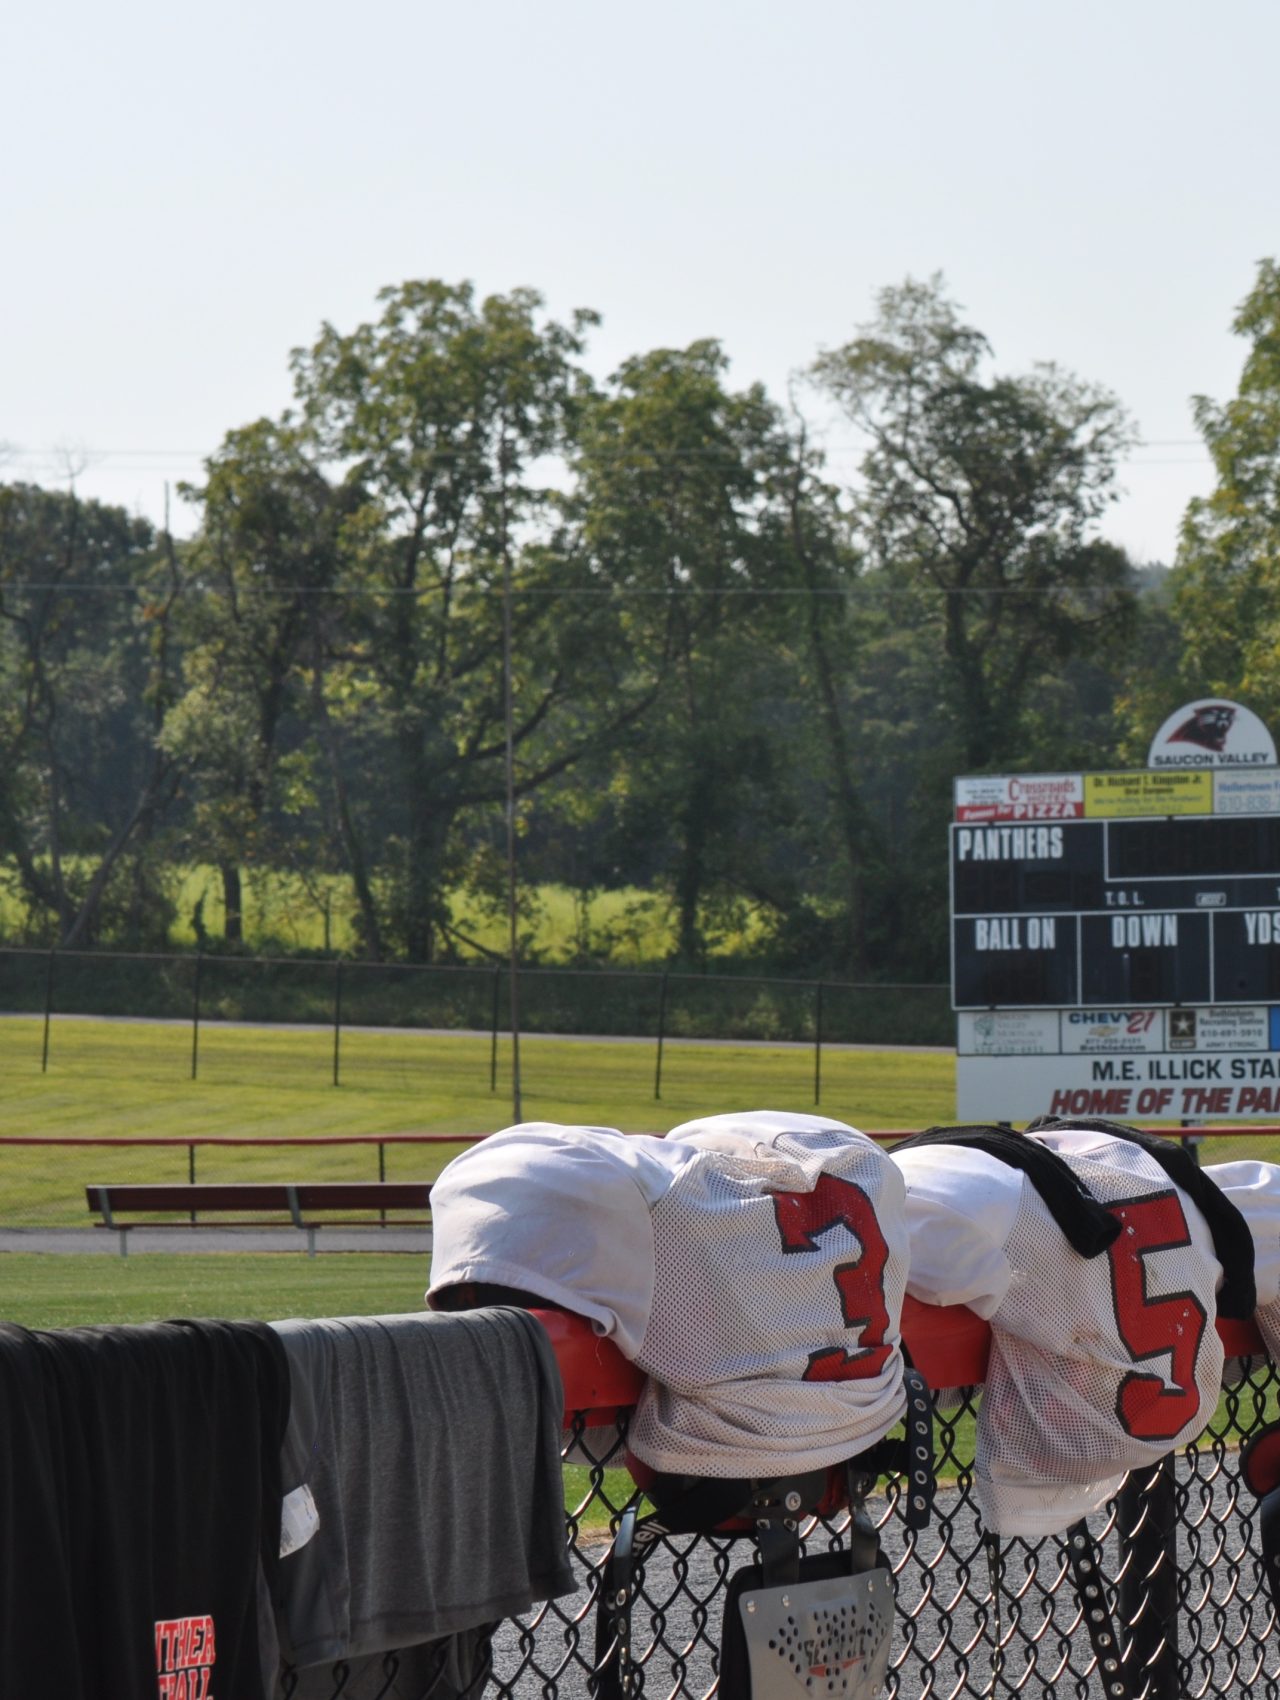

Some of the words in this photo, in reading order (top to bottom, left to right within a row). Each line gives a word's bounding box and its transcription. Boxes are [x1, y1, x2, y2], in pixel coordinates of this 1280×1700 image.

[1154, 754, 1214, 766] SAUCON
[1217, 752, 1269, 764] VALLEY
[1008, 777, 1076, 801] Crossroads
[1013, 803, 1077, 819] PIZZA
[958, 826, 1064, 861] PANTHERS
[975, 919, 1022, 951] BALL
[1027, 918, 1056, 949] ON
[1112, 914, 1178, 947] DOWN
[1068, 1012, 1133, 1024] CHEVY
[1126, 1010, 1156, 1034] 21
[1209, 1008, 1254, 1018] Bethlehem
[1080, 1044, 1146, 1052] Bethlehem
[1093, 1060, 1141, 1081] M.E.
[1149, 1059, 1222, 1080] ILLICK
[1050, 1088, 1133, 1115] HOME
[1136, 1088, 1174, 1115] OF
[1181, 1087, 1233, 1114] THE
[1102, 1188, 1207, 1441] 5
